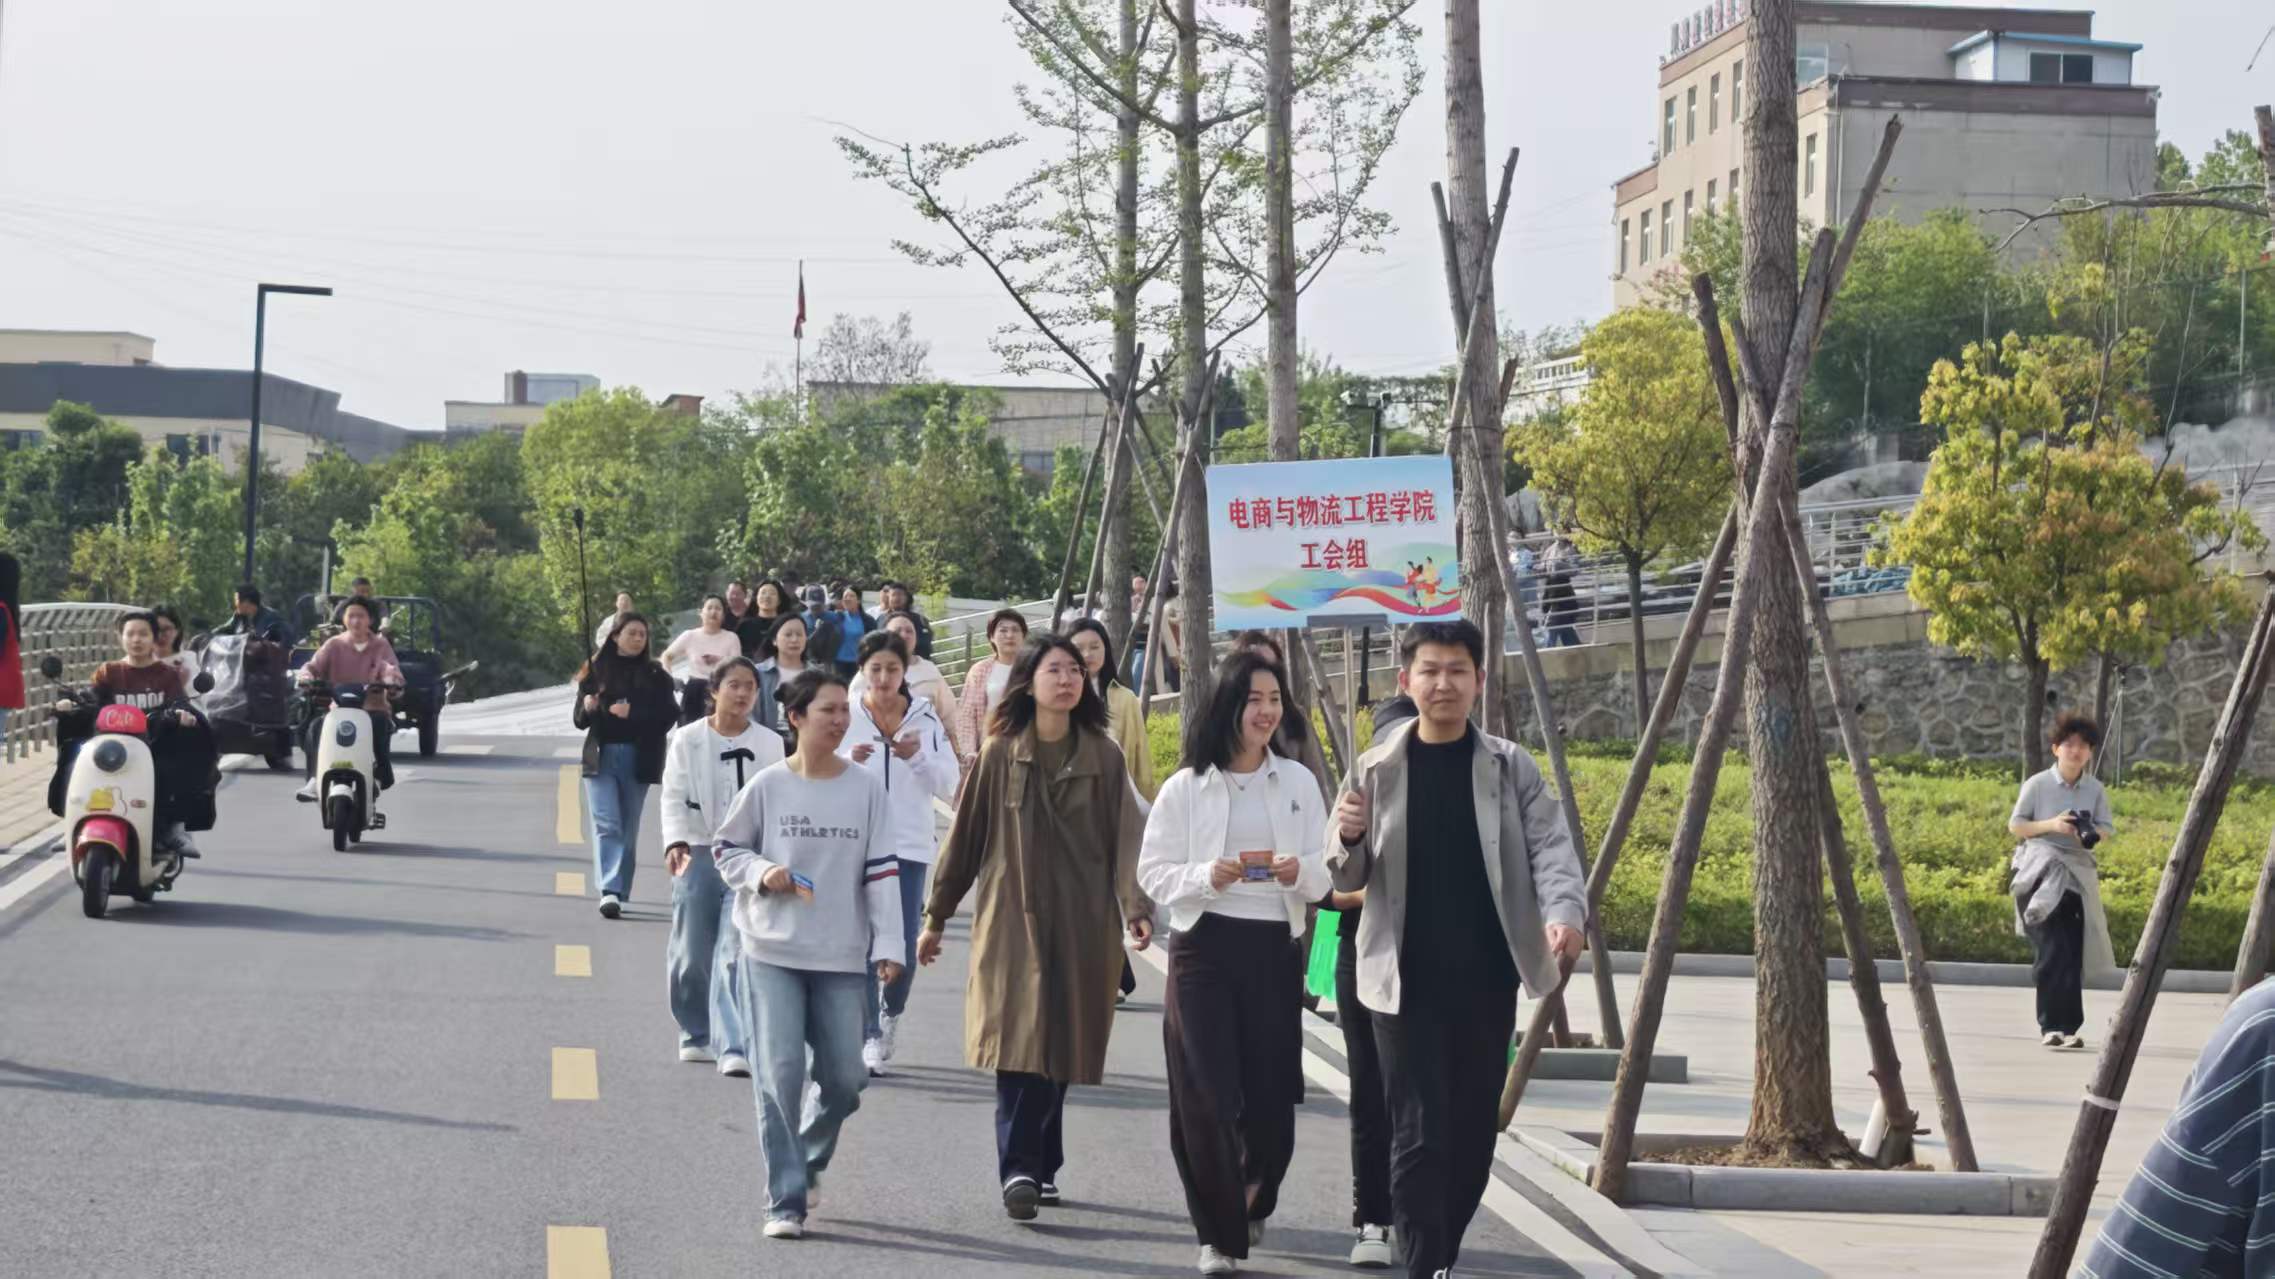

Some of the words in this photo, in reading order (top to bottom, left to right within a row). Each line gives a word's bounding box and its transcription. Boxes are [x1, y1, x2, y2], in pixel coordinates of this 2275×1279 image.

[1229, 489, 1436, 529] 电商与物流工程学院
[1300, 539, 1369, 570] 工会组
[780, 815, 811, 826] USA
[780, 827, 859, 839] ATHLETICS
